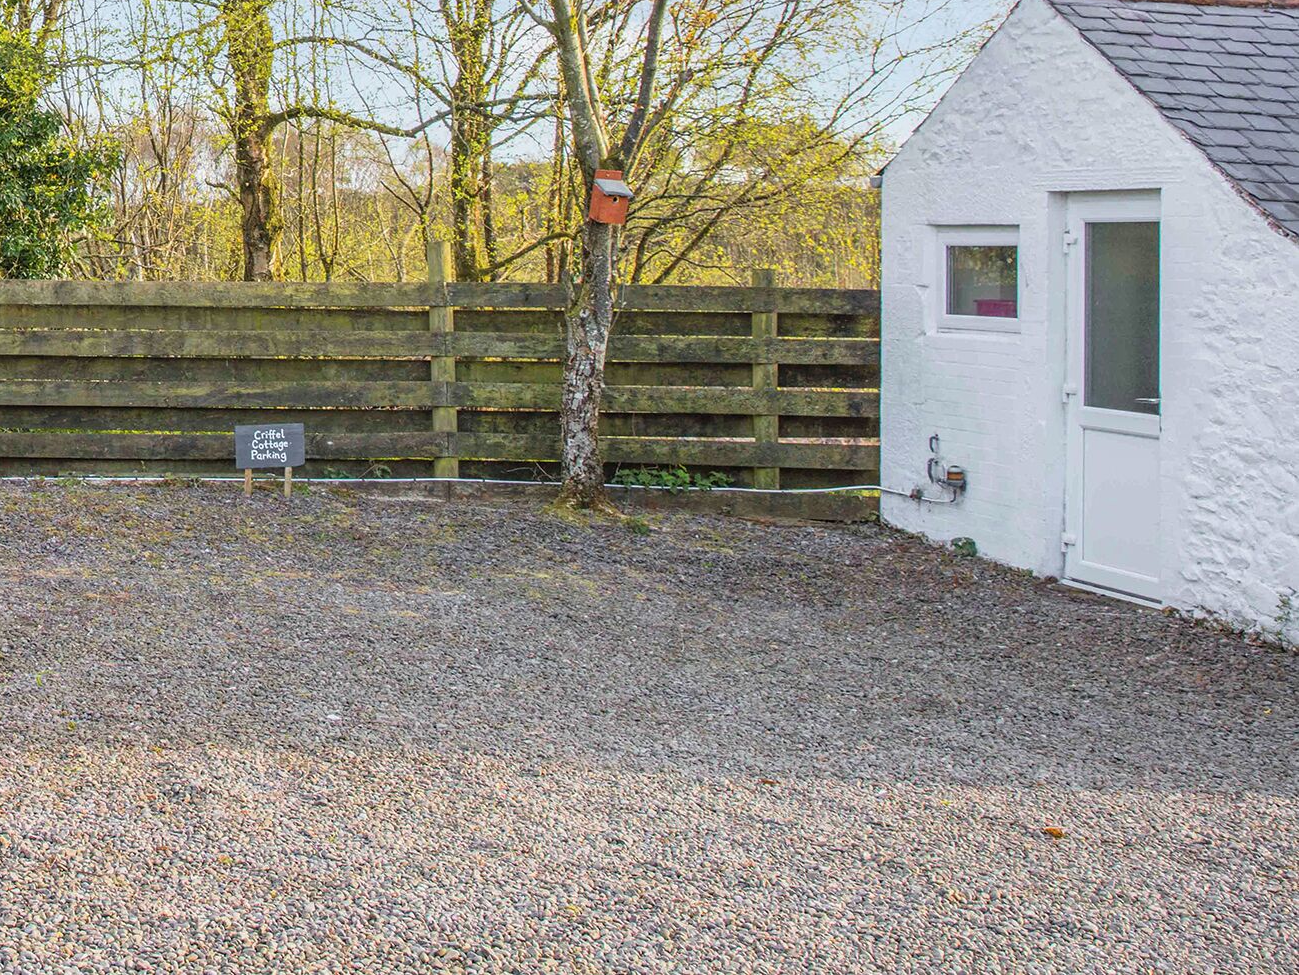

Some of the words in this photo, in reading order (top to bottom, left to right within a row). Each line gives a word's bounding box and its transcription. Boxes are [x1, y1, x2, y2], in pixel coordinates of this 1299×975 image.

[254, 429, 285, 440] Criffel
[251, 440, 289, 451] Cottage
[251, 450, 287, 462] Parking
